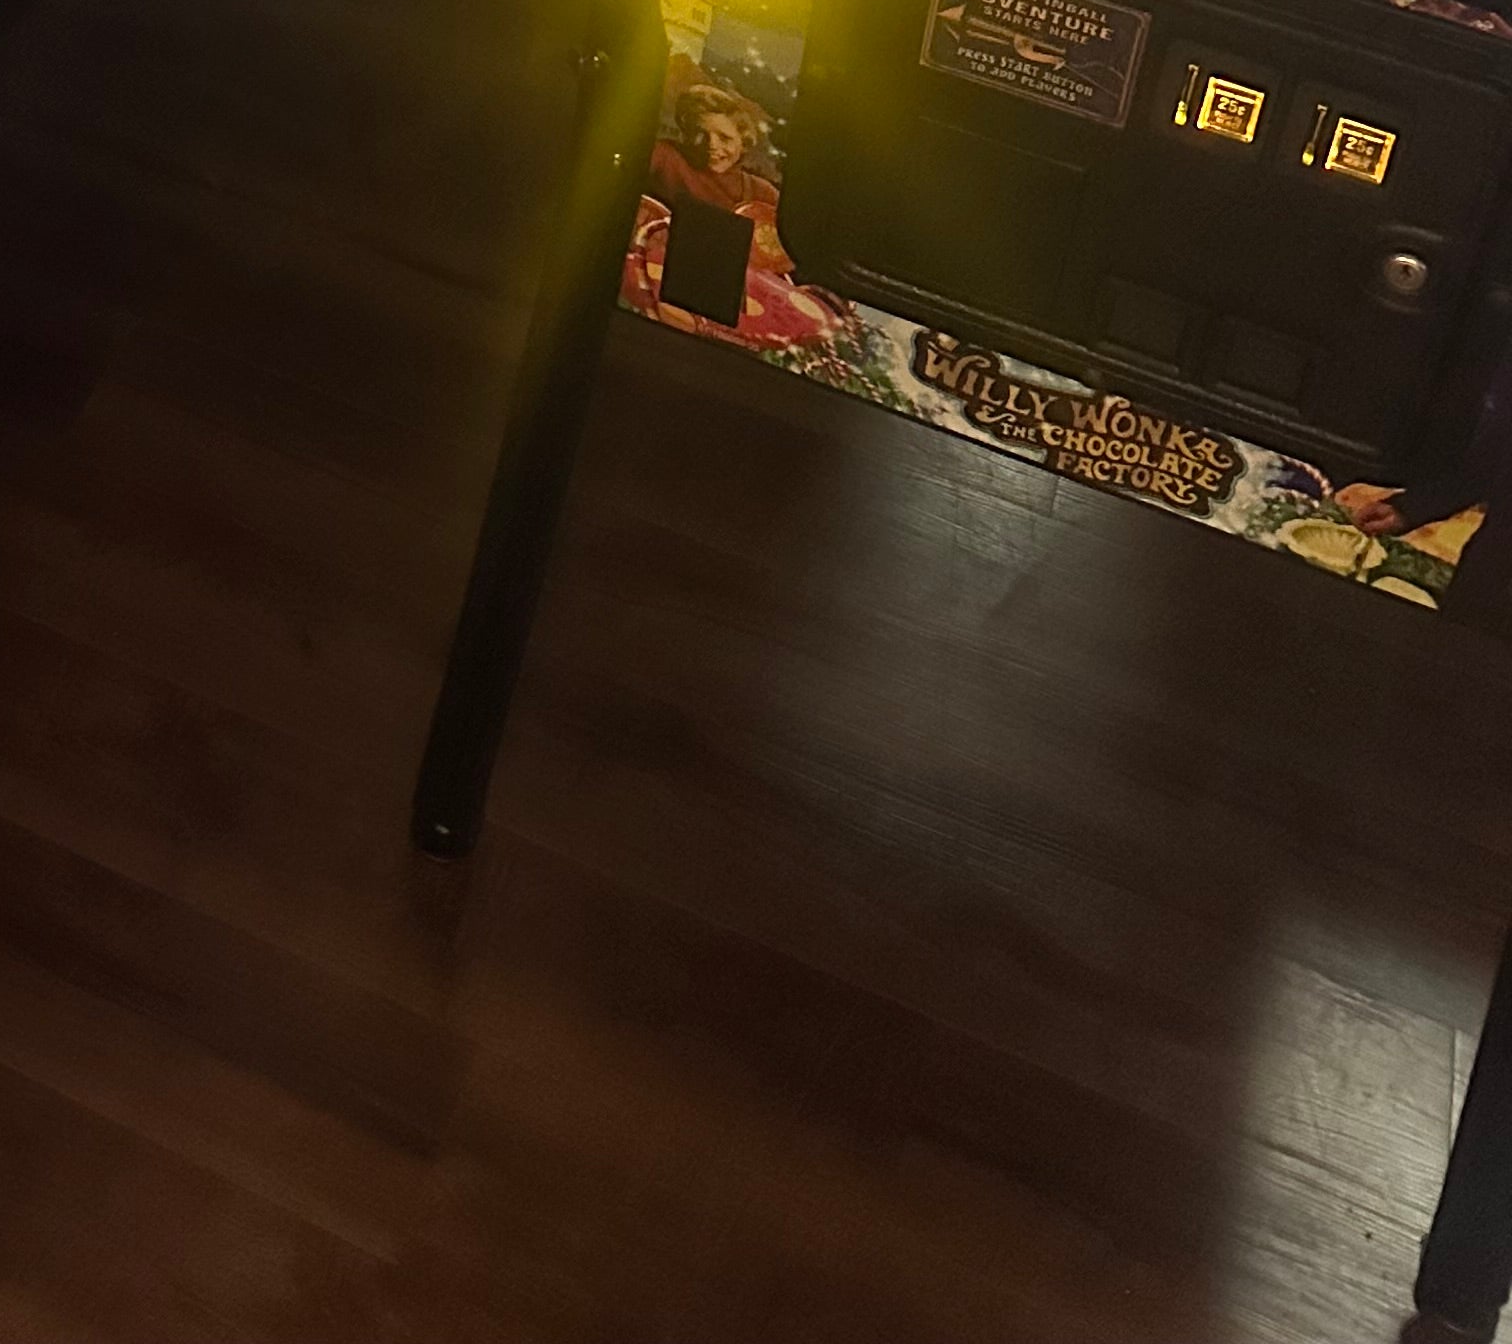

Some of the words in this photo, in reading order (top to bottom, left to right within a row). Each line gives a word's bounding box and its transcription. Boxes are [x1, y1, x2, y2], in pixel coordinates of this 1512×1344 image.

[983, 5, 1042, 31] STARTS
[1049, 26, 1090, 45] HERE
[971, 61, 986, 73] TO
[1000, 56, 1041, 78] START
[1042, 71, 1095, 97] BUTTON
[924, 332, 1060, 421] WILLY
[1069, 394, 1234, 469] WONKA
[1000, 421, 1038, 443] THE
[1040, 420, 1224, 493] CHOCOLATE
[1056, 451, 1199, 506] FACTORY
